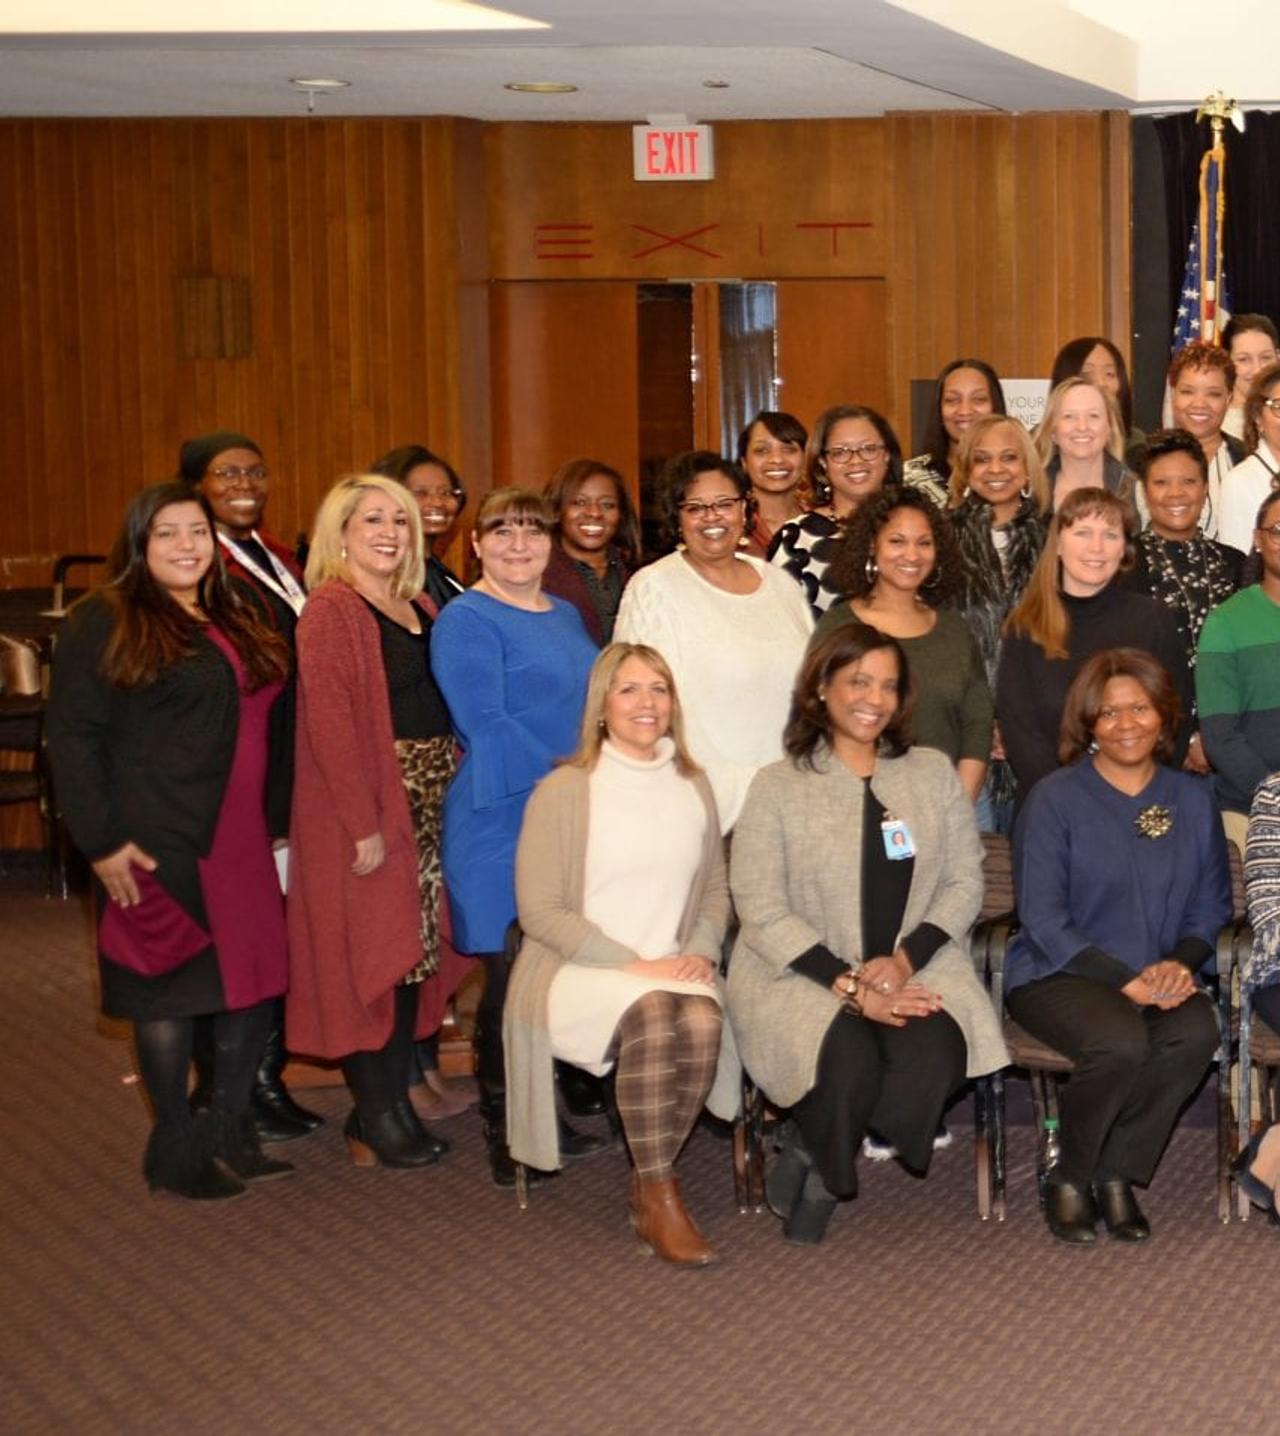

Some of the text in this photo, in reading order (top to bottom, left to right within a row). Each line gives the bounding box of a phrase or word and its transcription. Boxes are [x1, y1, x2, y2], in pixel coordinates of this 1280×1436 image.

[646, 131, 699, 175] EXIT
[534, 223, 873, 259] EXIT
[1007, 396, 1045, 408] YOUR
